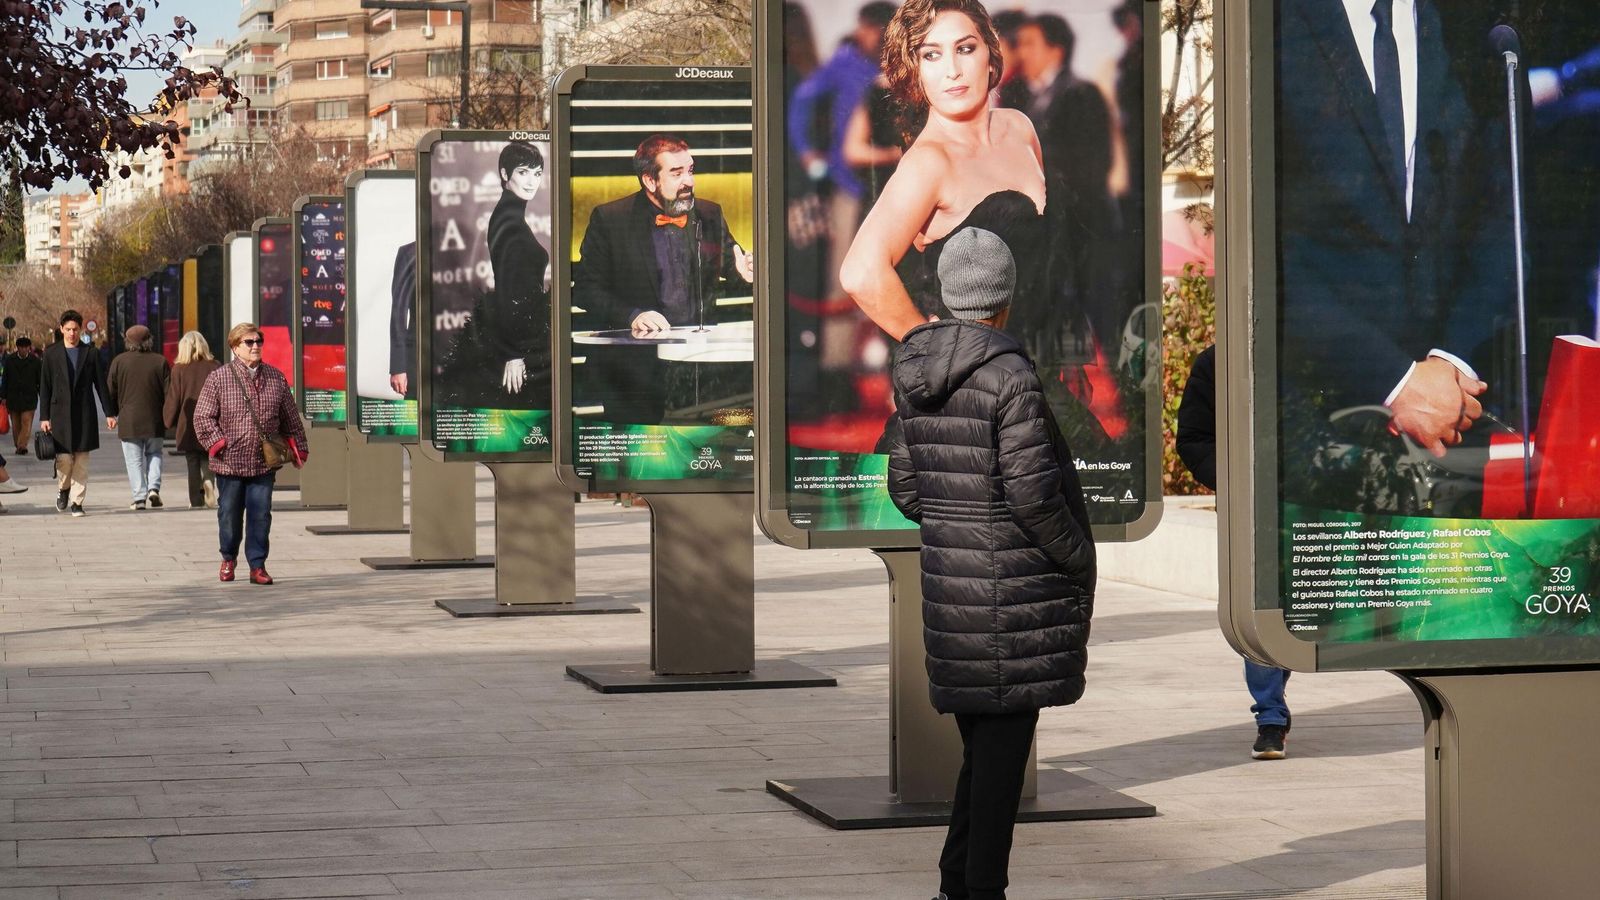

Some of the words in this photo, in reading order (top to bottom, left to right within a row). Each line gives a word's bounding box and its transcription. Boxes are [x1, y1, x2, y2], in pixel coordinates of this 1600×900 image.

[676, 68, 733, 78] JCDecaux
[440, 218, 466, 251] A
[316, 264, 328, 278] A
[314, 299, 332, 309] rtve
[690, 460, 722, 470] GOYA
[1379, 530, 1425, 539] Rodríguez
[1433, 529, 1461, 537] Rafael
[1333, 543, 1359, 552] premio
[1366, 543, 1388, 551] Mejor
[1412, 541, 1449, 550] Adaptado
[1410, 553, 1426, 561] gala
[1359, 566, 1396, 575] Rodríguez
[1549, 566, 1571, 583] 39
[1422, 577, 1440, 585] Goya
[1300, 591, 1334, 599] guionista
[1396, 600, 1414, 608] Goya
[1526, 594, 1591, 614] GOYA
